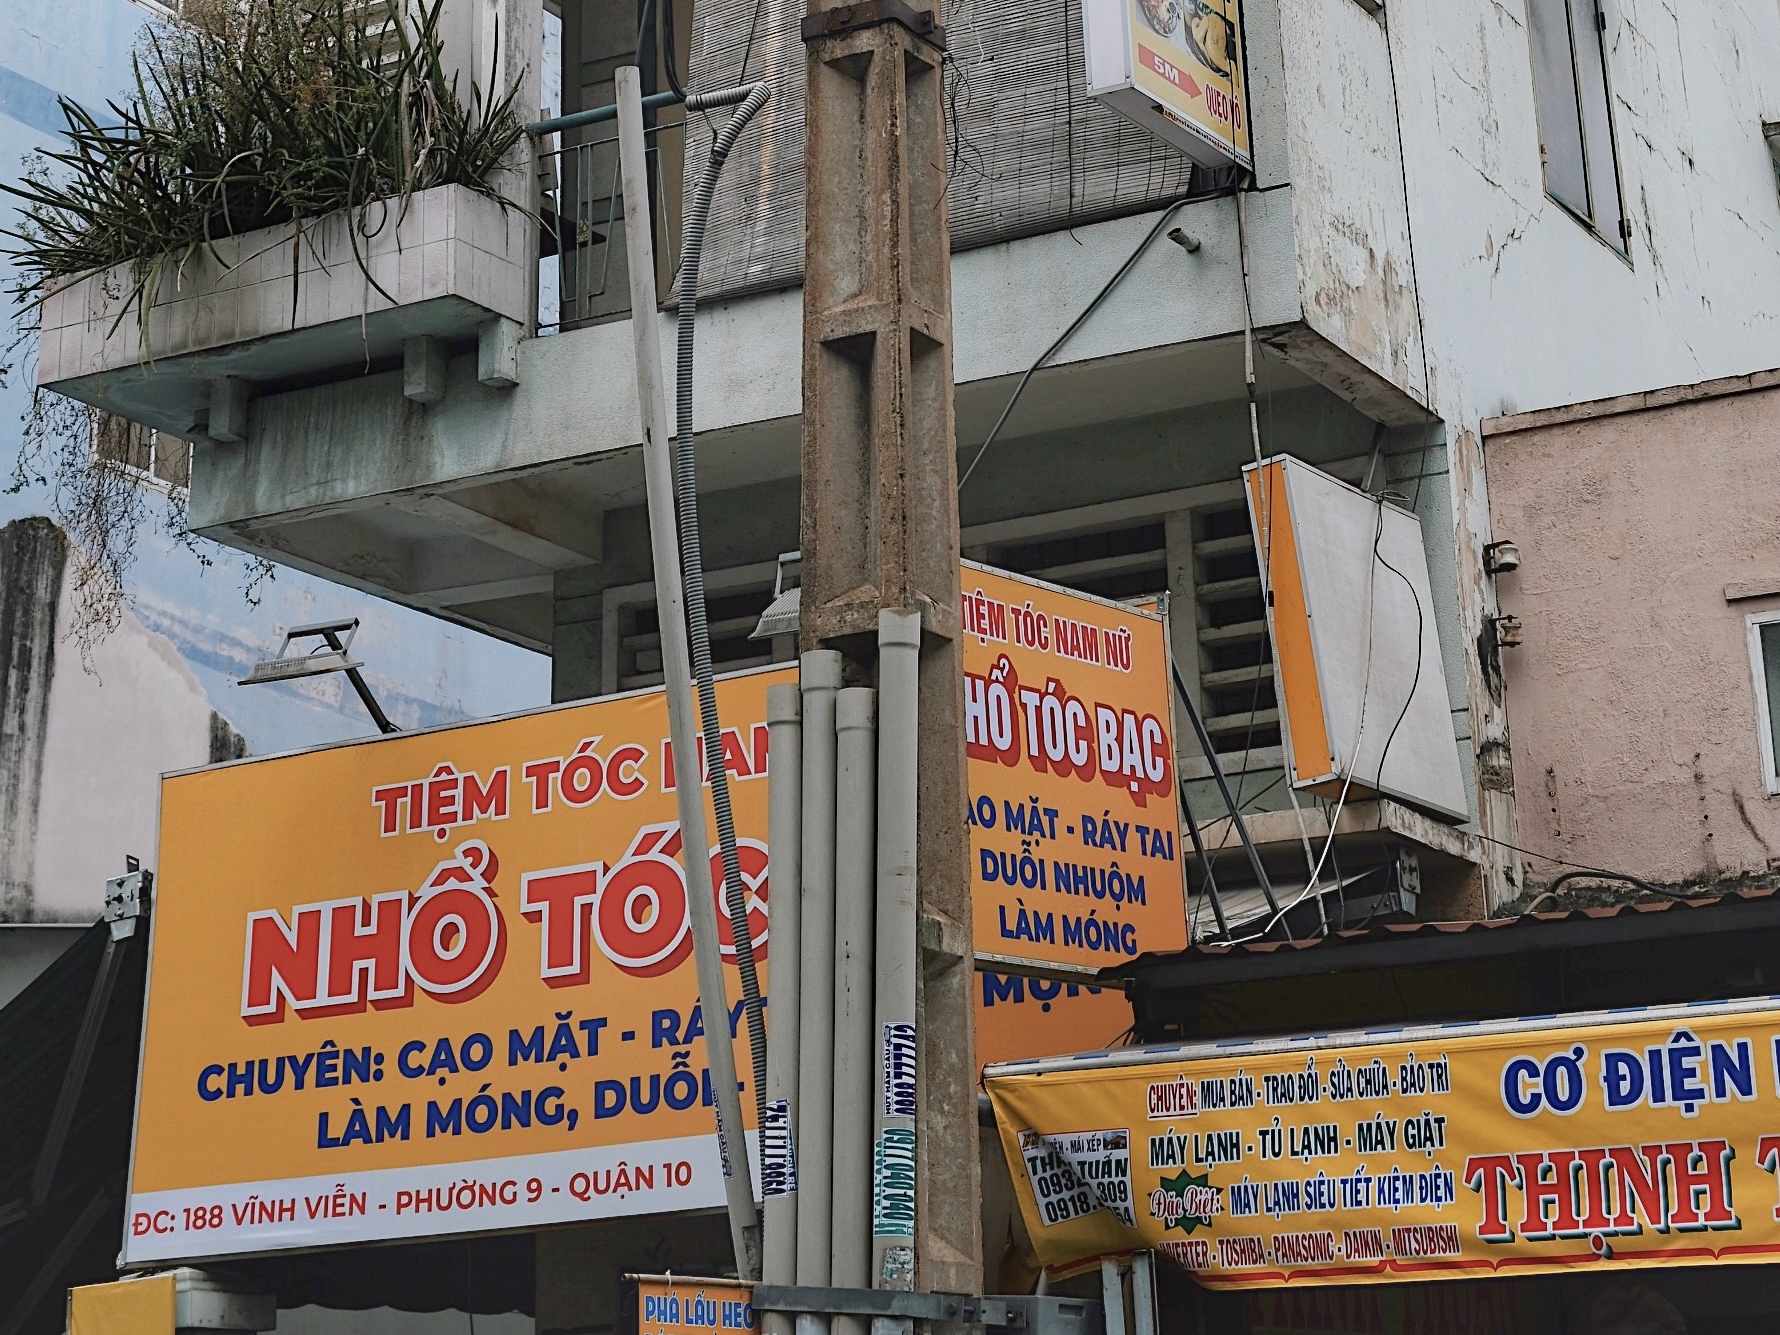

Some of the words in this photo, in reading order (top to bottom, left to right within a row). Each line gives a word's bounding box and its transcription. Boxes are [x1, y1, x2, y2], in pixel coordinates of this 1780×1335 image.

[1155, 56, 1179, 84] 5M
[1009, 601, 1049, 653] TÓC
[1053, 615, 1101, 666] NAM
[1102, 625, 1132, 673] NỮ
[964, 656, 1016, 758] HỔ
[1019, 679, 1092, 773] TÓC
[1095, 703, 1168, 800] BẠC
[372, 762, 510, 843] TIỆM
[523, 735, 649, 814] TÓC
[1004, 796, 1059, 847] MẶT
[1082, 810, 1129, 852] RÁY
[1136, 825, 1174, 861] TAI
[980, 839, 1046, 890] DUỖI
[1054, 861, 1146, 911] NHUỘM
[241, 839, 507, 1027] NHỔ
[521, 820, 767, 993] TÓC
[999, 898, 1055, 944] LÀM
[1062, 909, 1137, 955] MÓNG
[197, 1040, 384, 1101] CHUYÊN:
[397, 1033, 493, 1086] CẠO
[508, 1011, 607, 1072] MẶT
[1148, 1075, 1198, 1115] CHUYÊN:
[1200, 1079, 1226, 1111] MUA
[1229, 1070, 1254, 1108] BÁN
[1263, 1072, 1295, 1106] TRAO
[1298, 1056, 1320, 1103] ĐỔI
[1329, 1058, 1353, 1101] SỬA
[1357, 1059, 1389, 1099] CHỮA
[1400, 1052, 1426, 1095] BẢO
[1428, 1053, 1450, 1093] TRÌ
[1501, 1042, 1588, 1118] CƠ
[1600, 1027, 1758, 1118] ĐIỆN
[317, 1098, 411, 1149] LÀM
[426, 1083, 579, 1131] MÓNG,
[1149, 1127, 1188, 1167] MÁY
[1194, 1131, 1242, 1170] LẠNH
[1259, 1116, 1283, 1159] TỦ
[1289, 1124, 1339, 1165] LẠNH
[1357, 1112, 1397, 1153] MÁY
[1404, 1111, 1446, 1158] GIẶT
[132, 1210, 175, 1236] ĐC:
[183, 1205, 223, 1230] 188
[231, 1195, 295, 1225] VĨNH
[305, 1183, 367, 1219] VIỄN
[396, 1179, 517, 1215] PHƯỜNG
[526, 1178, 542, 1202] 9
[569, 1162, 654, 1201] QUẬN
[663, 1161, 692, 1188] 10
[1077, 1152, 1128, 1180] TUẤN
[1229, 1176, 1260, 1217] MÁY
[1263, 1179, 1301, 1220] LẠNH
[1304, 1170, 1336, 1212] SIÊU
[1340, 1165, 1373, 1209] TIẾT
[1376, 1167, 1414, 1211] KIỆM
[1418, 1164, 1454, 1211] ĐIỆN
[1462, 1138, 1741, 1259] THỊNH
[1151, 1188, 1182, 1226] Đặc
[1184, 1185, 1221, 1224] Biệt:
[1159, 1239, 1211, 1270] VERTER
[1217, 1236, 1266, 1268] TOSHIBA
[1273, 1231, 1335, 1265] PANASONIC
[1343, 1229, 1384, 1261] DAIKIN
[1391, 1224, 1461, 1257] MITSUBISHI
[645, 1291, 679, 1324] PHÁ
[684, 1290, 717, 1327] LẤU
